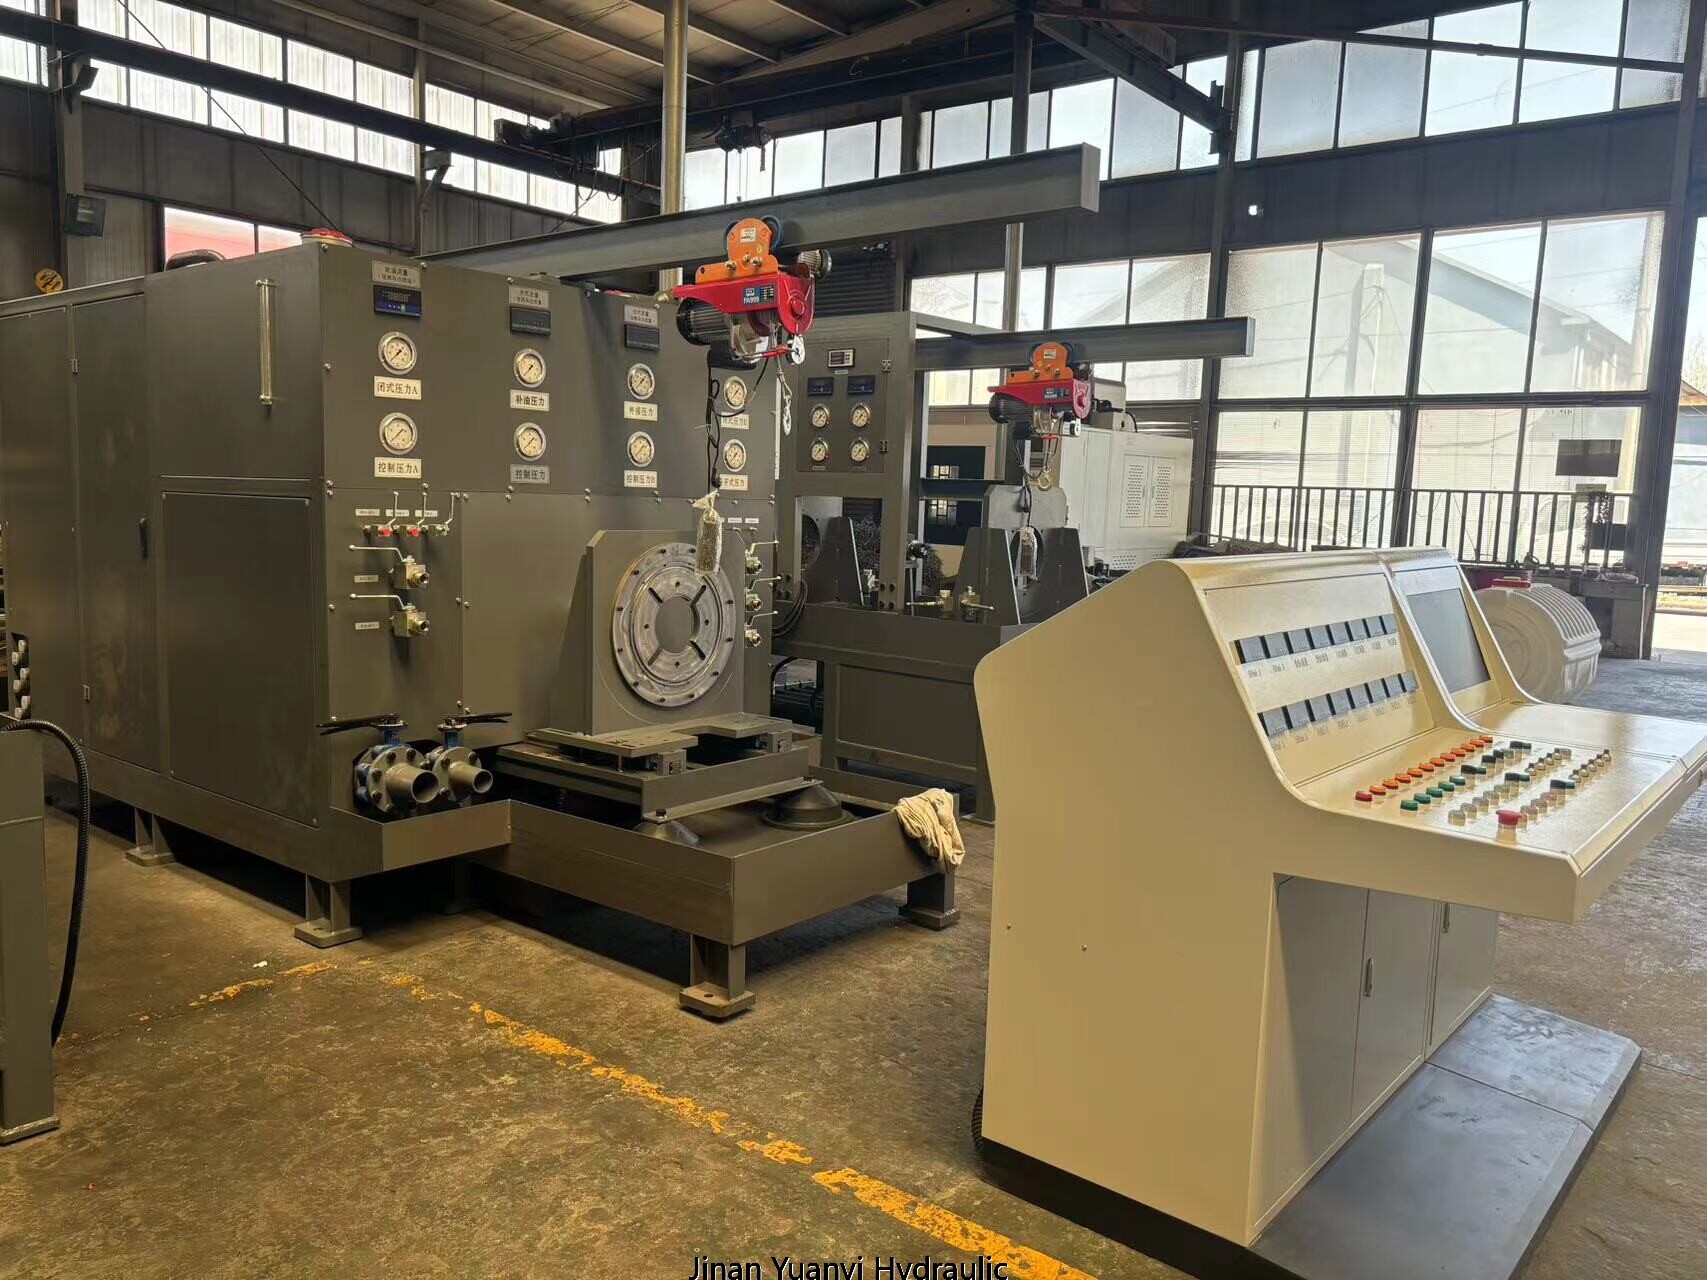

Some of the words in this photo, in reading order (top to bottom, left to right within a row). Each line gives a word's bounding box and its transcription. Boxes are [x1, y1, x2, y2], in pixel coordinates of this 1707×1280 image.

[376, 381, 418, 395] 闭式压力A
[515, 394, 545, 407] 补油压力
[377, 461, 419, 474] 控制压力A
